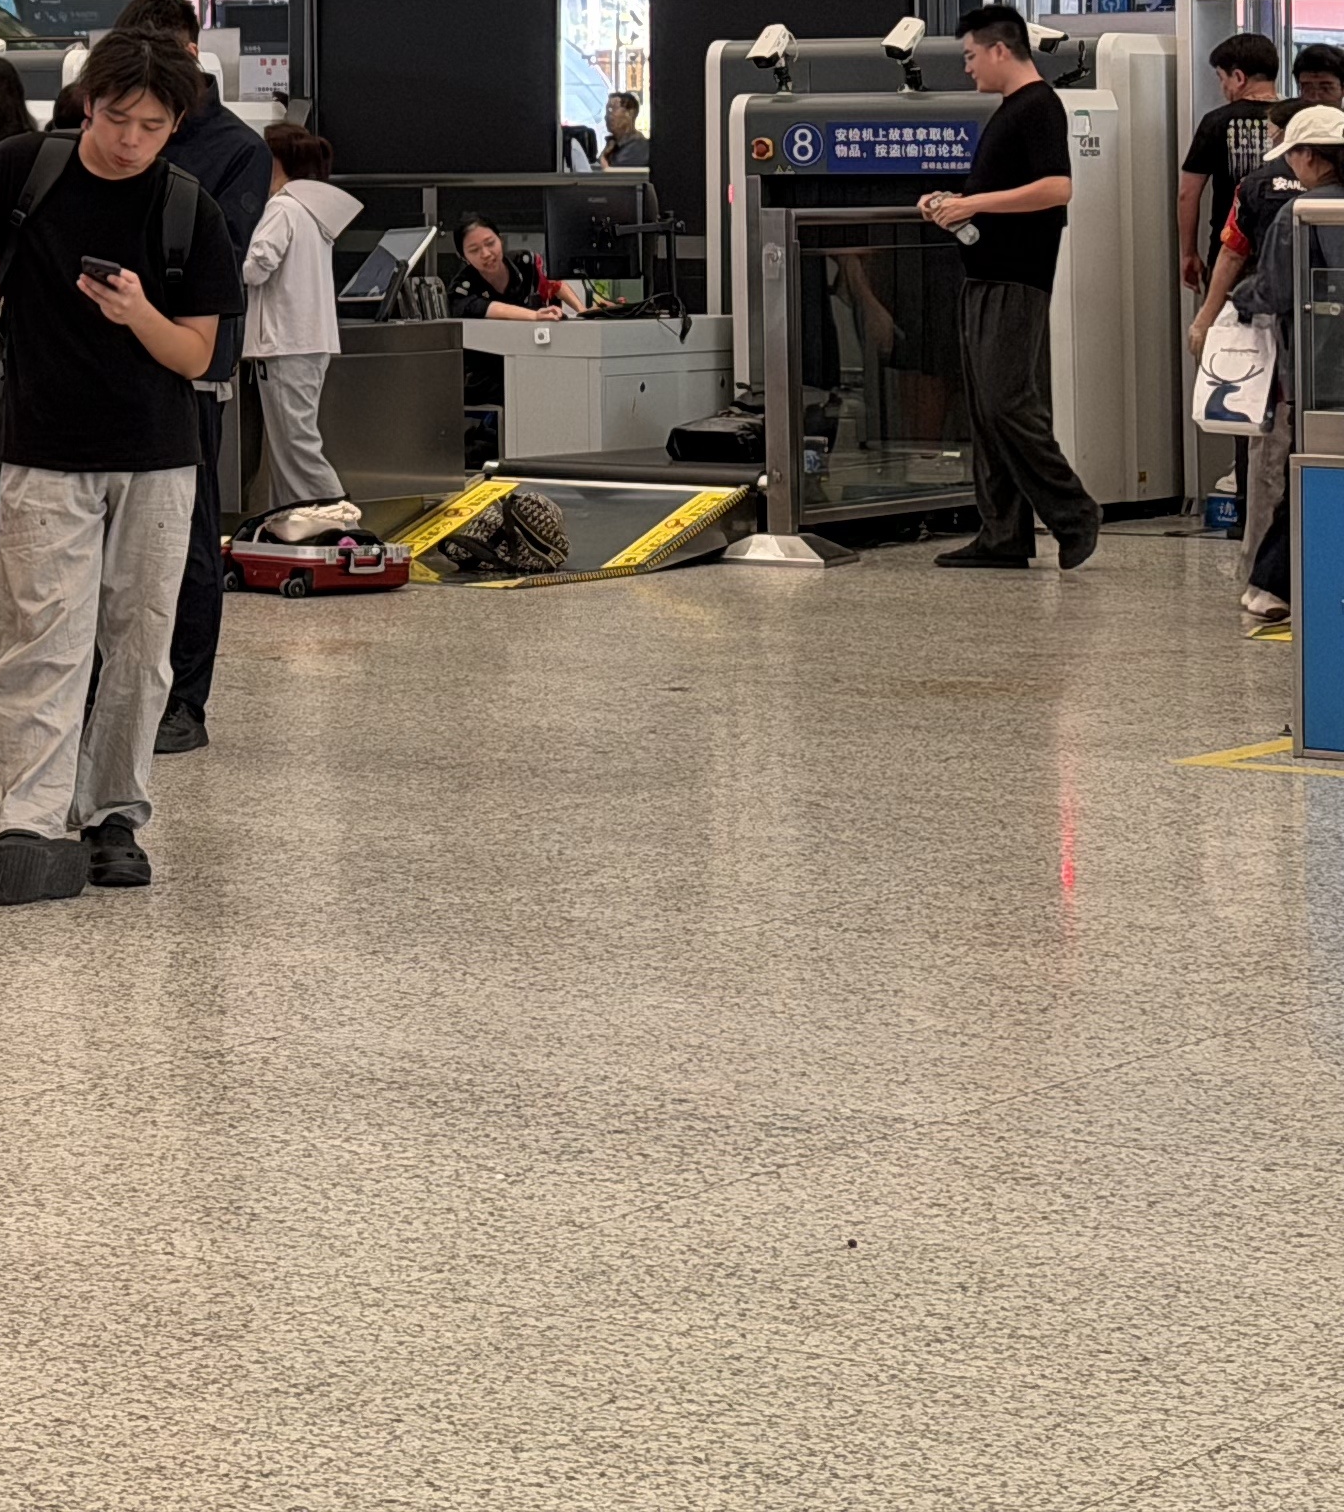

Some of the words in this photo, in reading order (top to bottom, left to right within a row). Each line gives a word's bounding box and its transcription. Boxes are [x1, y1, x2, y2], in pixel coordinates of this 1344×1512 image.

[792, 129, 814, 160] 8
[835, 127, 969, 142] 安检机上故意拿取他人
